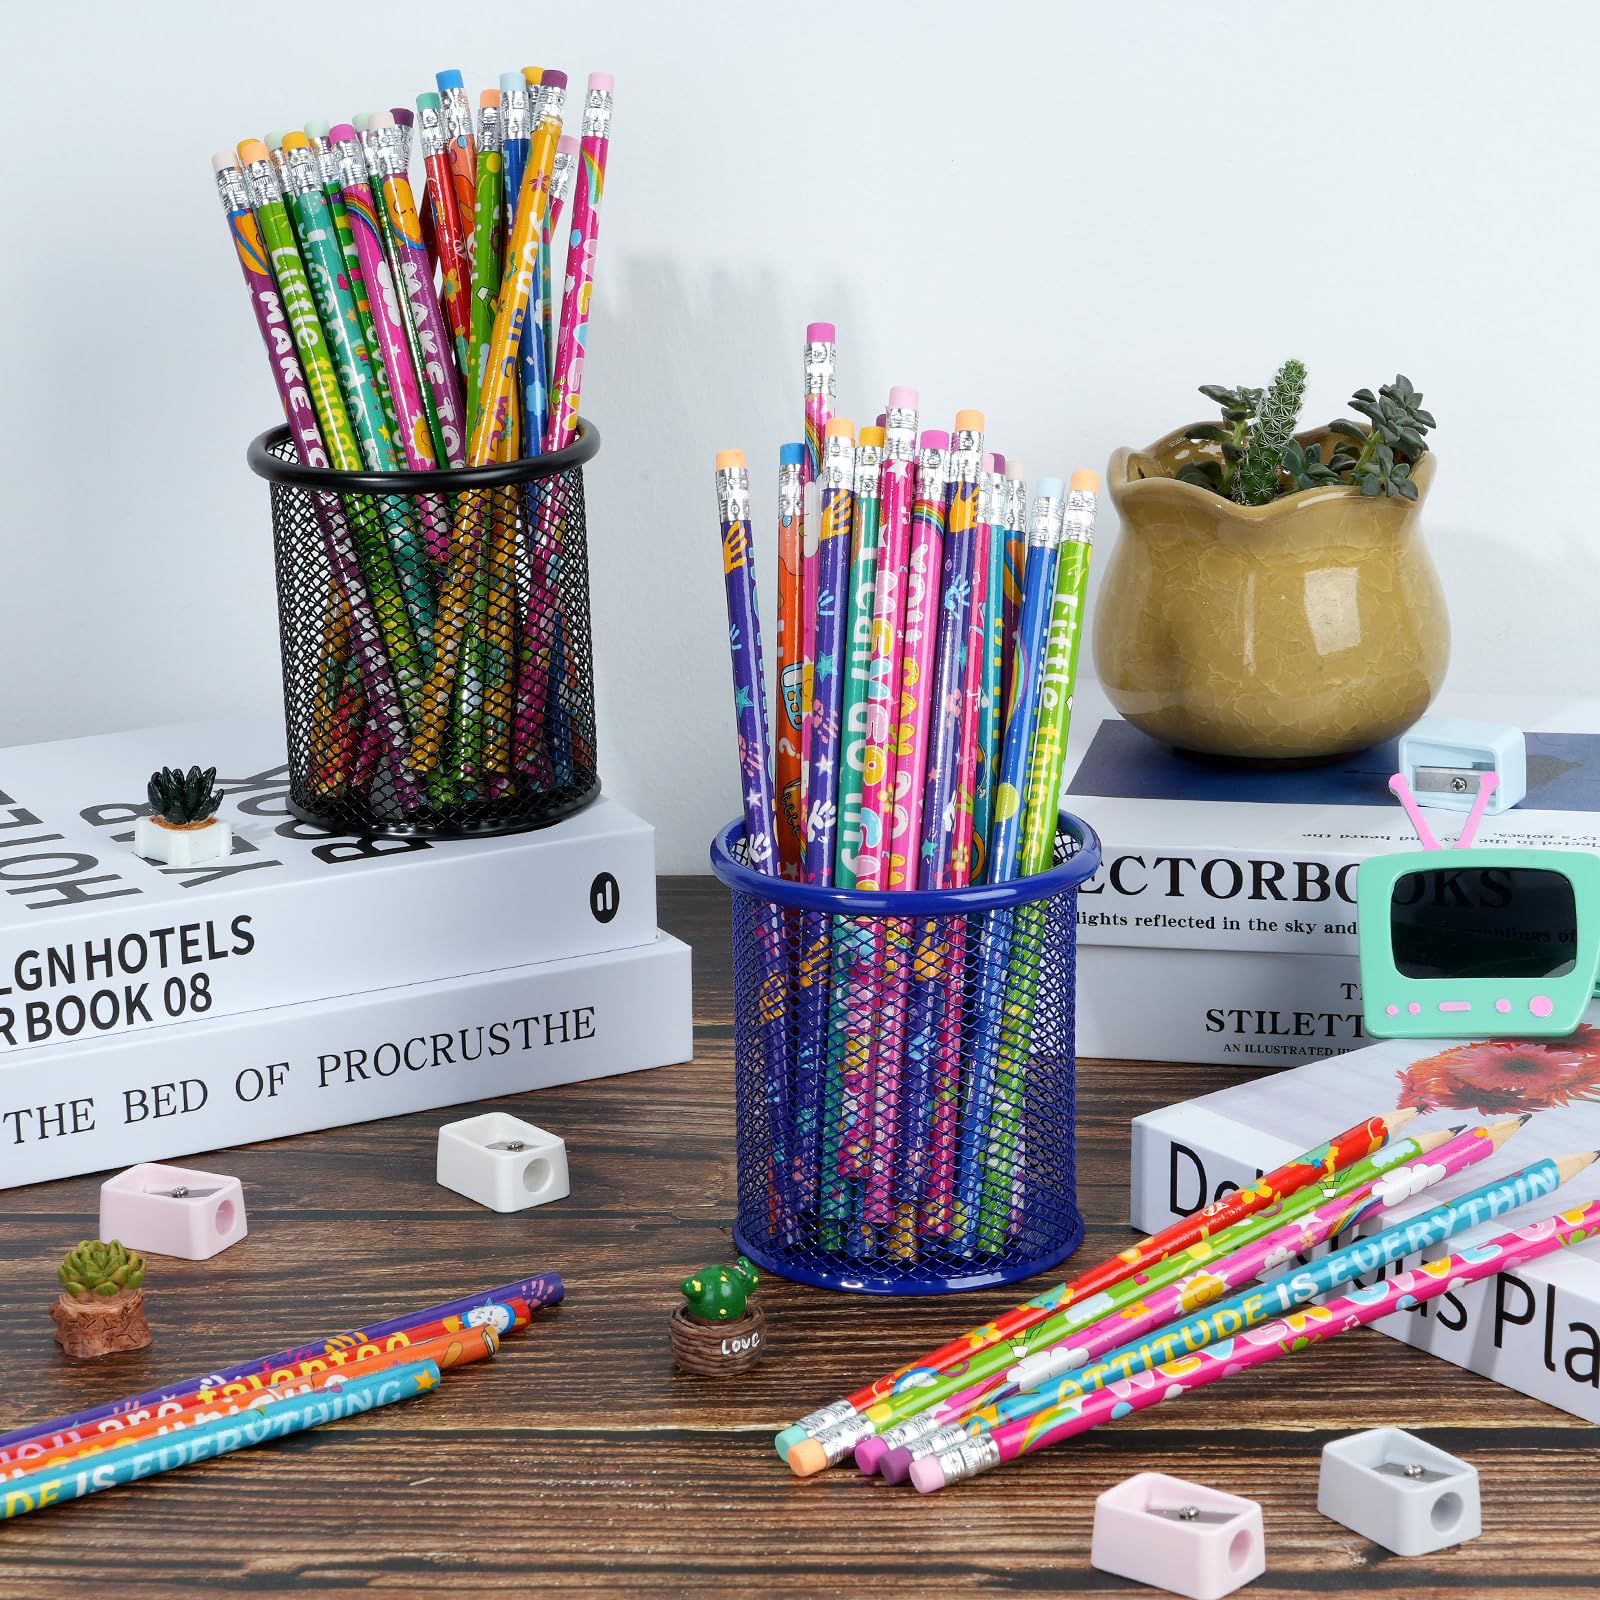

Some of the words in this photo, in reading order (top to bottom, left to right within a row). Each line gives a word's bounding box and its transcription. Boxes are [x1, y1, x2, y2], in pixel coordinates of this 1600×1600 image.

[259, 290, 312, 413] MAKE
[270, 247, 319, 349] Little
[305, 357, 359, 471] things
[1042, 593, 1078, 708] Little
[85, 914, 255, 981] HOTELS
[1077, 911, 1128, 926] lights
[1135, 913, 1216, 930] reflected
[1223, 916, 1240, 931] in
[1248, 917, 1278, 932] the
[1285, 919, 1317, 935] sky
[1324, 921, 1358, 935] and
[26, 982, 153, 1043] BOOK
[164, 972, 212, 1017] 08
[1223, 1043, 1241, 1052] AN
[1245, 1044, 1334, 1057] ILLUSTRATED
[2, 1098, 96, 1145] THE
[122, 1078, 209, 1124] BED
[235, 1061, 290, 1102] OF
[317, 1005, 597, 1088] PROCRUSTHE
[1058, 1293, 1268, 1404] ATTITUDE
[1276, 1271, 1319, 1311] IS
[75, 1464, 119, 1499] IS
